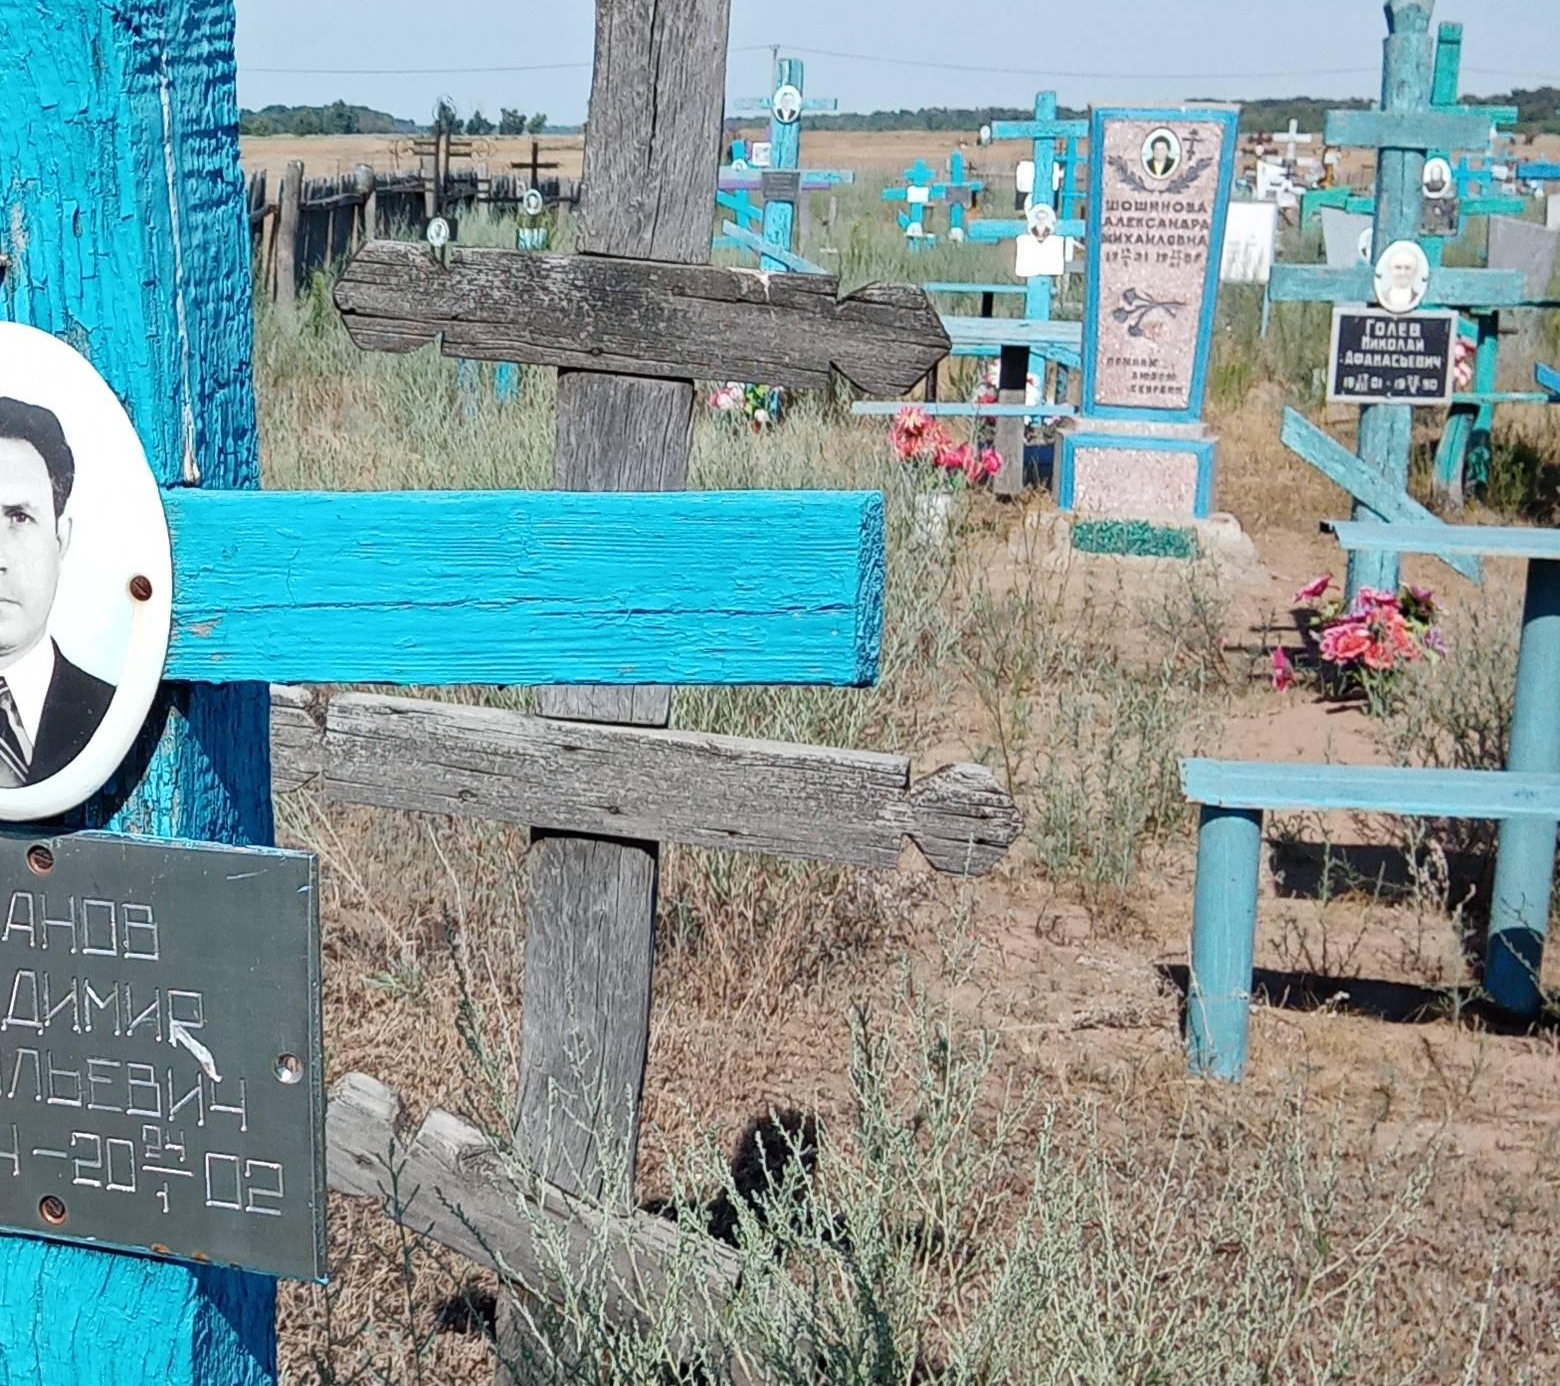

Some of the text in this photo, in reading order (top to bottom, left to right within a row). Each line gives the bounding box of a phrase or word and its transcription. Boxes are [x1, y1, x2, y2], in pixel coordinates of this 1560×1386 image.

[1103, 216, 1210, 230] АЛЕКСАНДРА
[1365, 318, 1422, 338] ГОЛЕВ
[1360, 335, 1425, 352] НИКОЛАЙ
[1344, 350, 1443, 370] АФАНАСЬЕВИЧ
